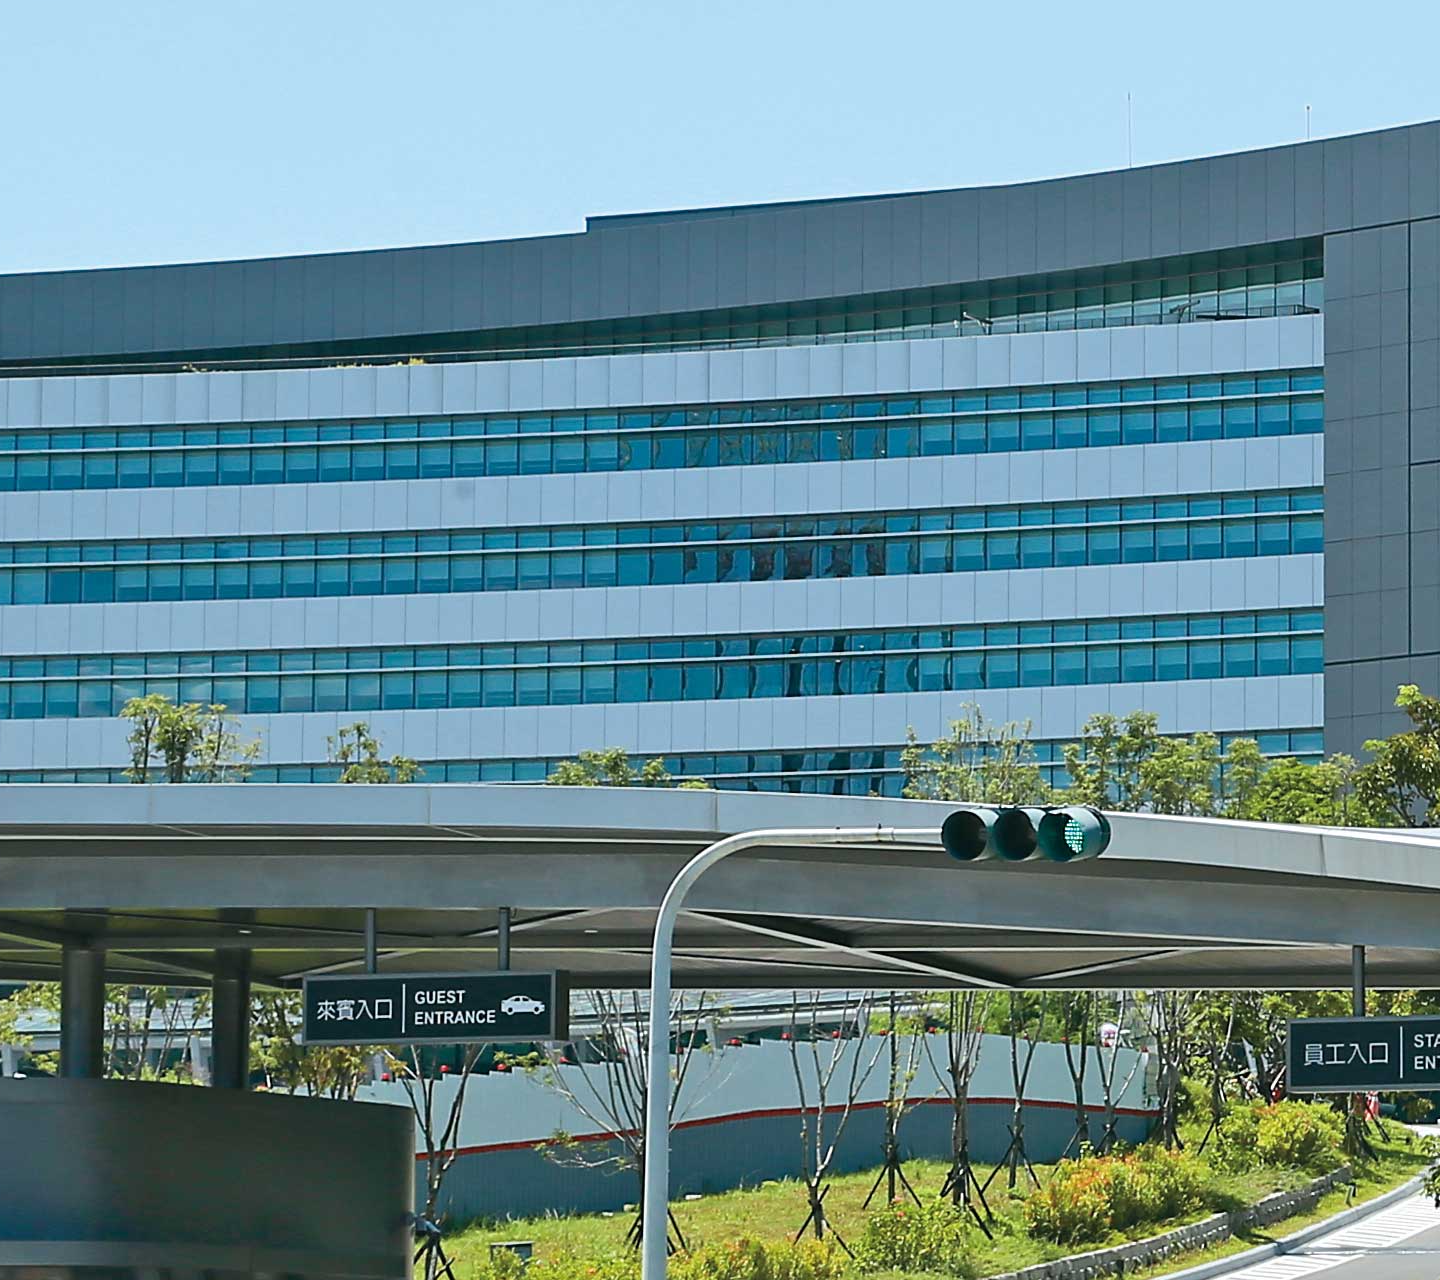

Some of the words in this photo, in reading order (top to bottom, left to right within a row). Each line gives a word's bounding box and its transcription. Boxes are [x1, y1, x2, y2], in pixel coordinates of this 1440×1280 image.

[414, 990, 466, 1004] GUEST
[317, 998, 393, 1021] 來賓入口
[414, 1009, 496, 1025] ENTRANCE
[1304, 1042, 1389, 1066] 員工入口
